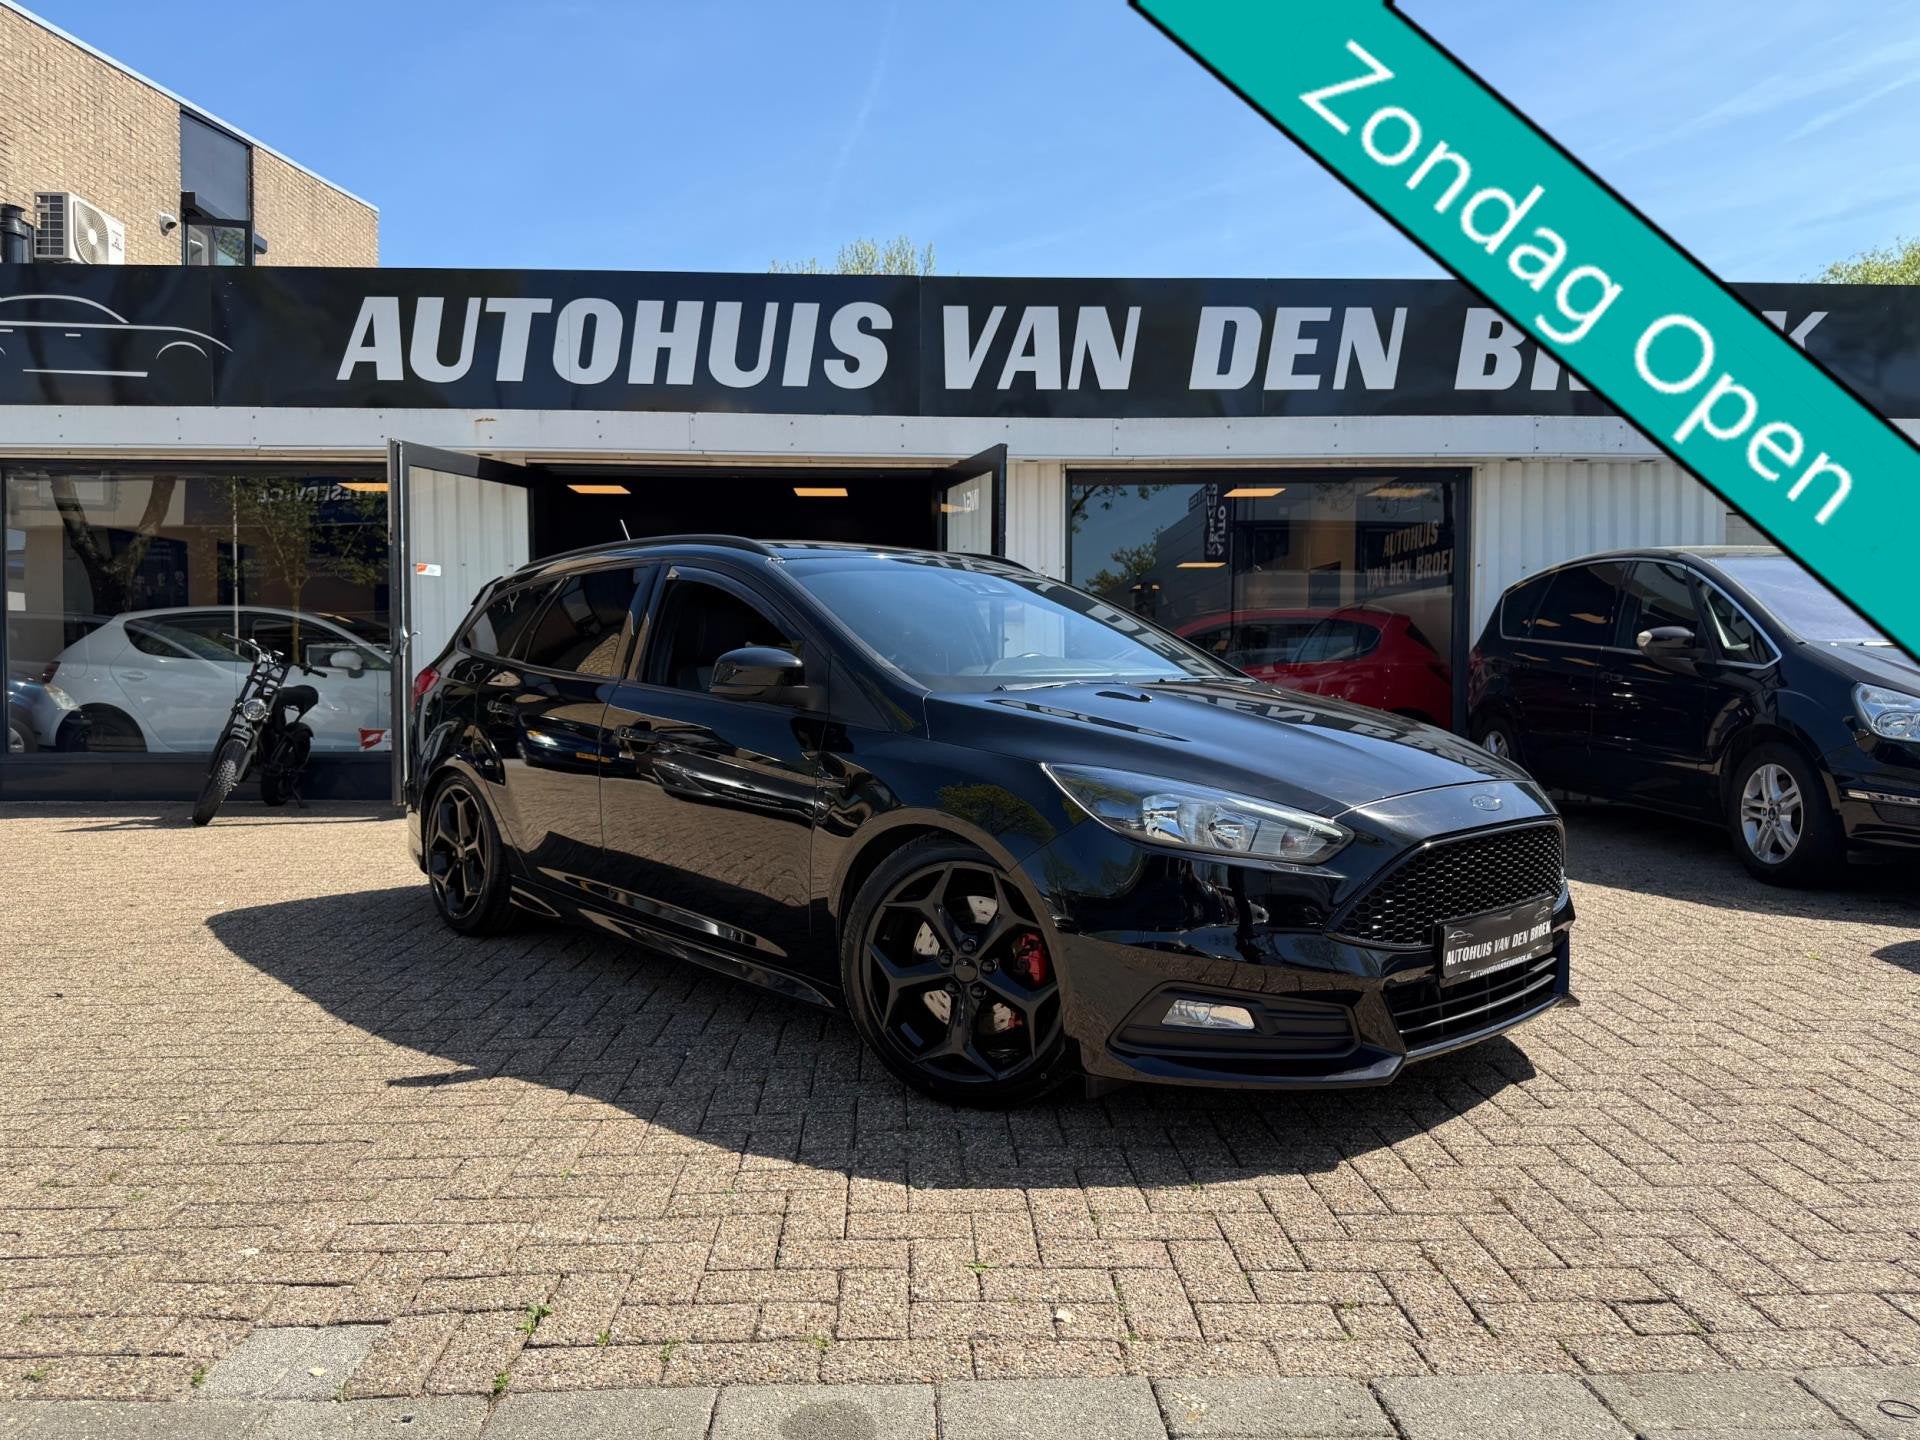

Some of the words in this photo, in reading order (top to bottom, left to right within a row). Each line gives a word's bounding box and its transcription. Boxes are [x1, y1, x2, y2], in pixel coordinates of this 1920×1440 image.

[336, 296, 893, 390] AUTOHUIS
[942, 305, 1142, 390] VAN
[1188, 306, 1408, 391] DEN
[1383, 520, 1440, 558] AUTOHUIS
[1389, 559, 1412, 585] DEN
[1445, 941, 1492, 966] AUTOHUIS
[1494, 935, 1511, 953] VAN
[1511, 929, 1530, 948] DEN
[1530, 920, 1552, 943] BROEK
